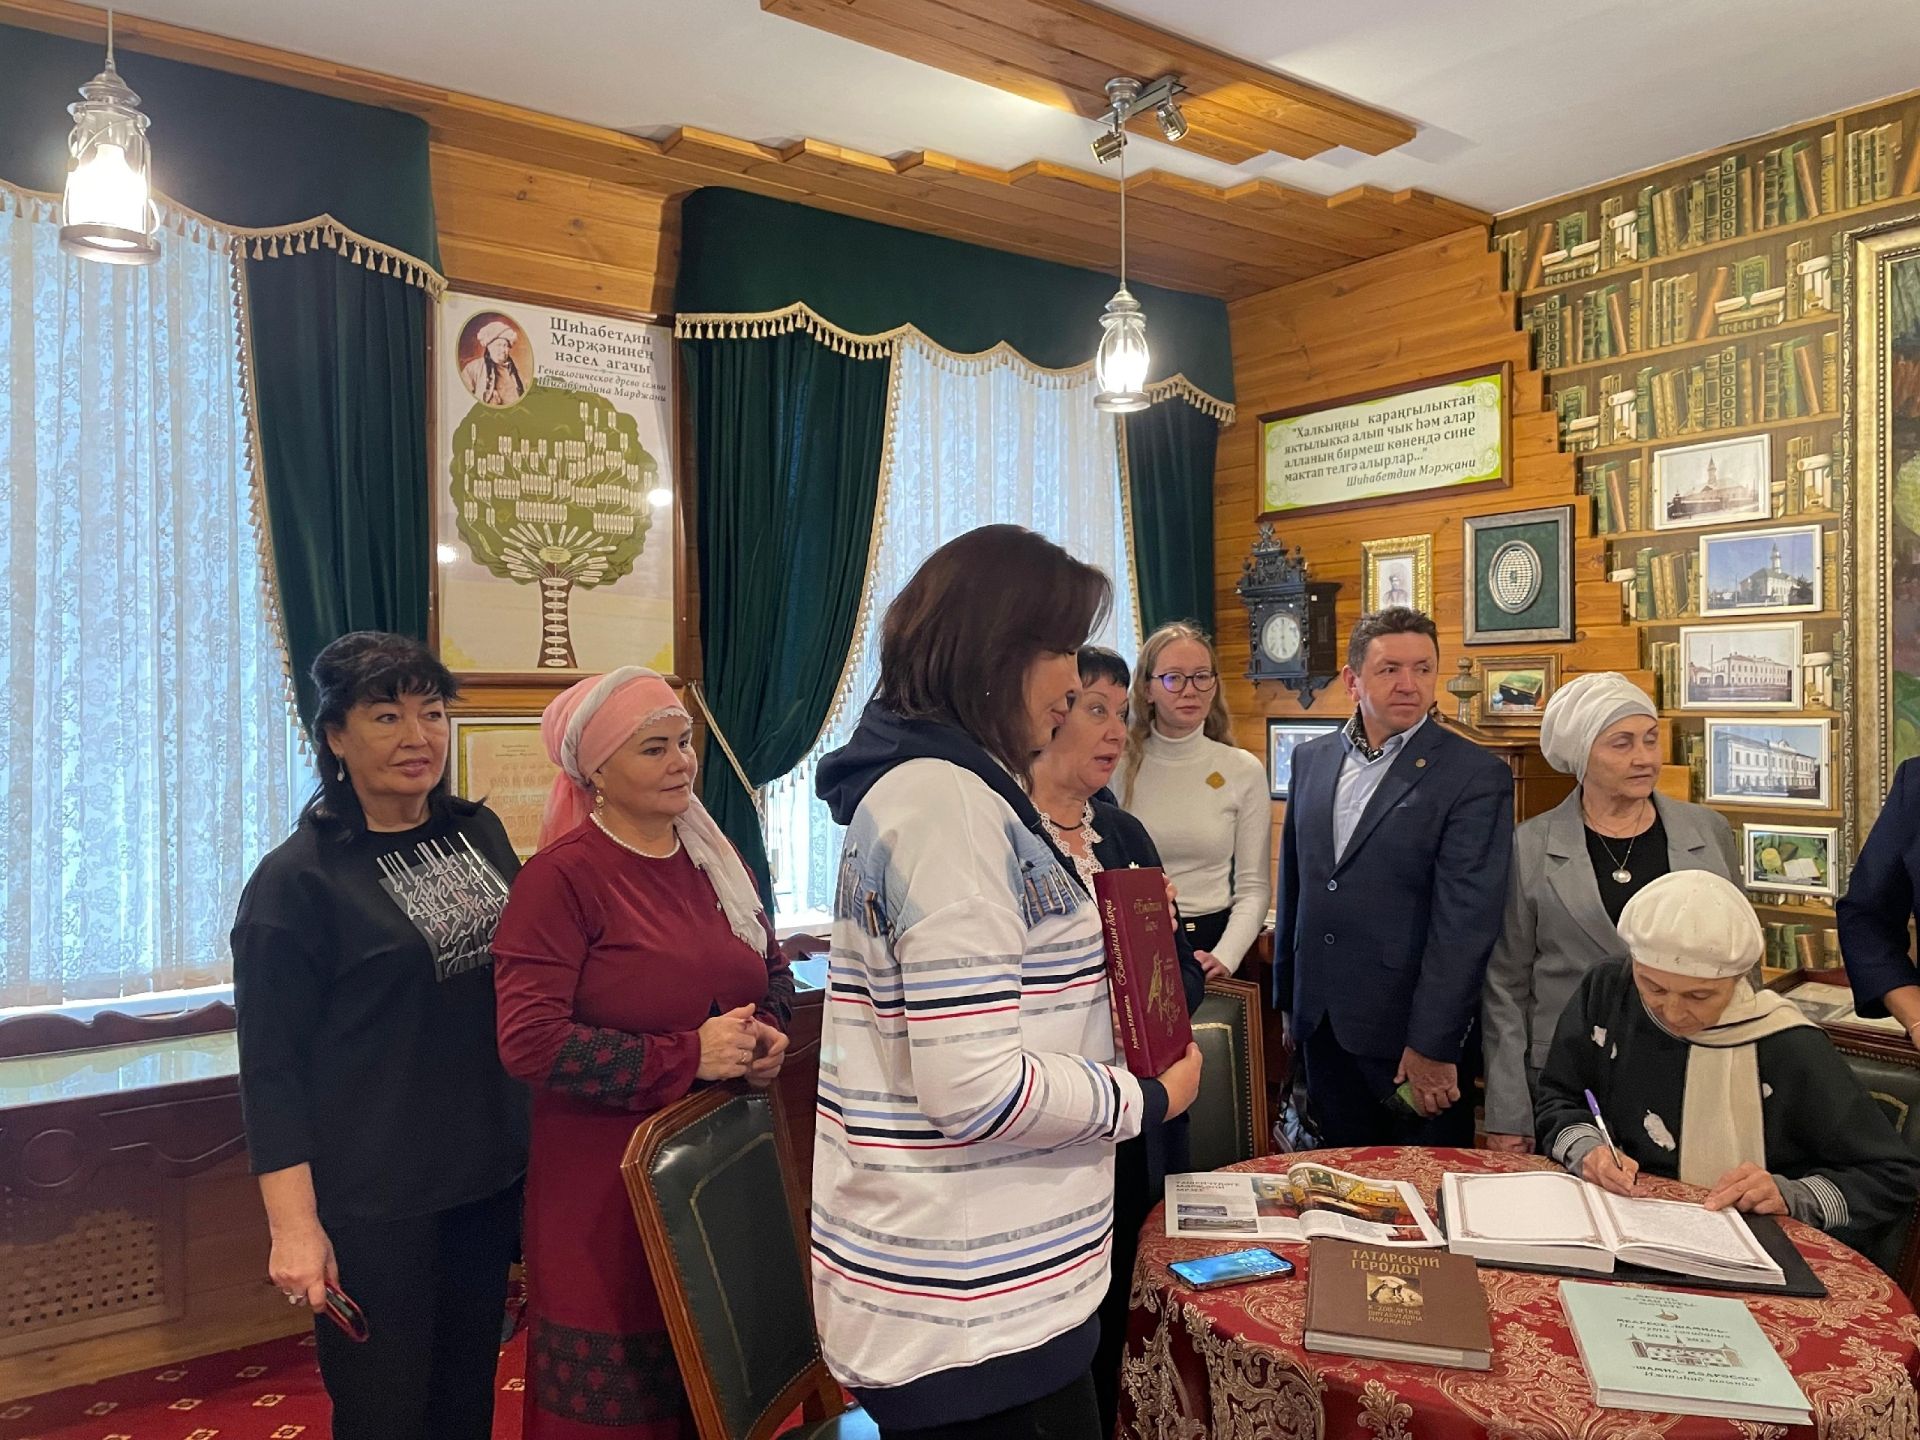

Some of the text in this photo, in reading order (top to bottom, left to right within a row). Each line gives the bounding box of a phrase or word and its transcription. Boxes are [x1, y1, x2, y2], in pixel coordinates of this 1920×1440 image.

[550, 316, 651, 346] Шиһабетдин
[551, 332, 655, 362] Мәрҗәнинең
[555, 351, 651, 375] нәсел агачы
[537, 364, 615, 384] Генеалогическое
[615, 374, 640, 391] древо
[613, 386, 667, 403] Марджани
[1367, 393, 1476, 426] караңгылыктан
[1284, 410, 1476, 456] яктылыкка алып чык һәм алар
[1284, 426, 1476, 470] алланың бирмеш көнендә сине
[1284, 467, 1325, 483] мактап
[1325, 461, 1358, 478] телгә
[1346, 458, 1477, 488] Шиһабетдин Мәрҗани
[1351, 1249, 1441, 1270] ТАТАРСКИЙ
[1351, 1259, 1422, 1277] ГЕРОДОТ
